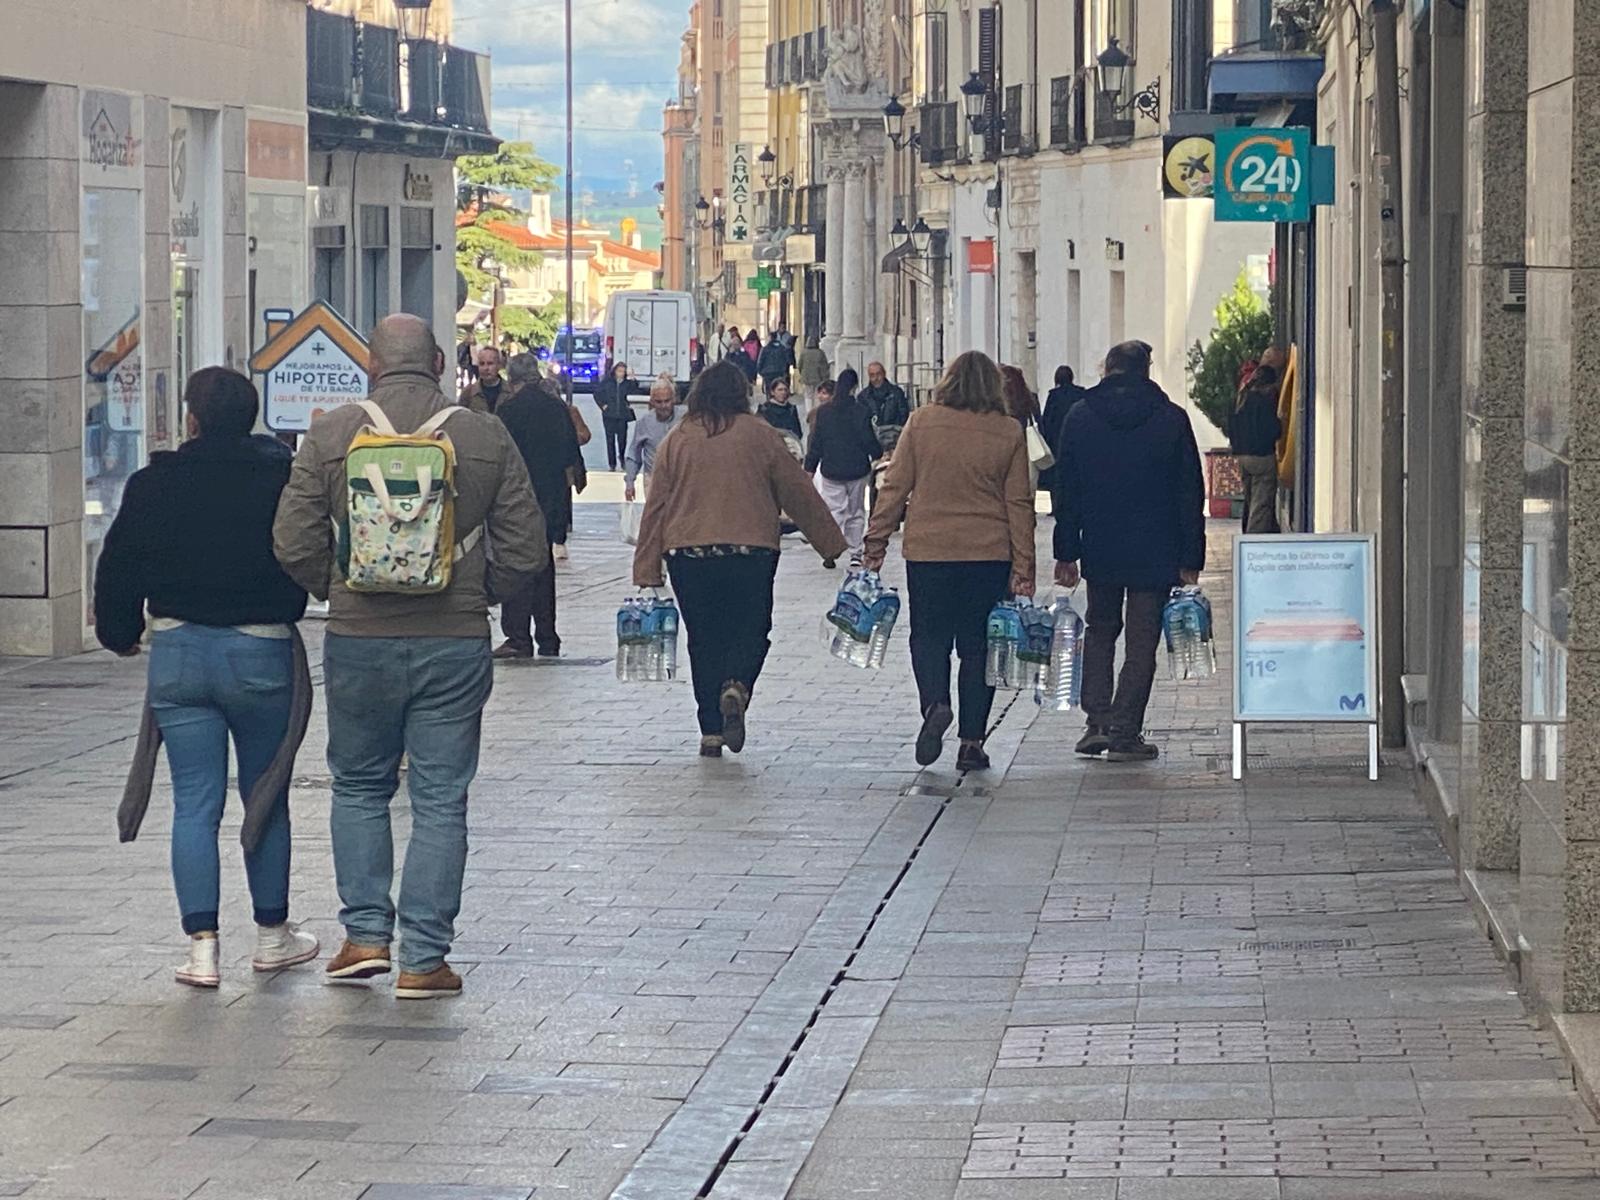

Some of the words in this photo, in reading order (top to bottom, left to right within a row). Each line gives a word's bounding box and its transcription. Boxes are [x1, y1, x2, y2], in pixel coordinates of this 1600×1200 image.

[732, 144, 749, 223] FARMACIA
[285, 362, 342, 371] MEJORAMOS
[274, 372, 361, 385] HIPOTECA
[301, 384, 313, 393] DE
[315, 385, 328, 393] TU
[329, 385, 362, 394] BANCO
[1247, 551, 1288, 560] Disfruta
[1288, 551, 1298, 560] lo
[1332, 551, 1345, 560] de
